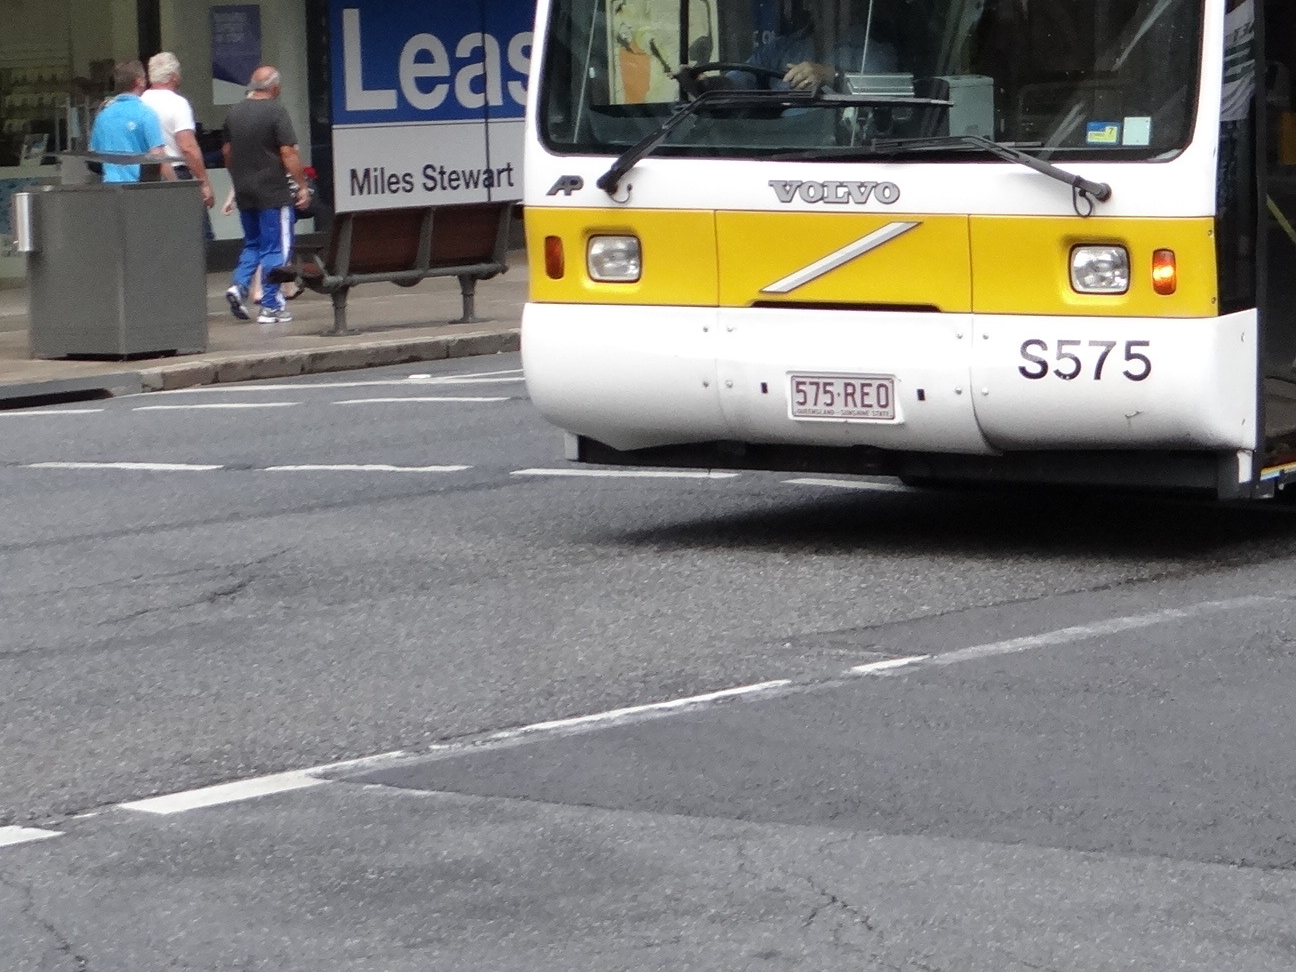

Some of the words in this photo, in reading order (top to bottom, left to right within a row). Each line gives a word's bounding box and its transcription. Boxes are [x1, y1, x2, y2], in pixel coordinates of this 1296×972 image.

[350, 167, 414, 196] Miles
[422, 162, 514, 191] Stewart
[546, 175, 584, 196] AP
[769, 180, 900, 204] VOLVO
[1018, 338, 1152, 382] S575
